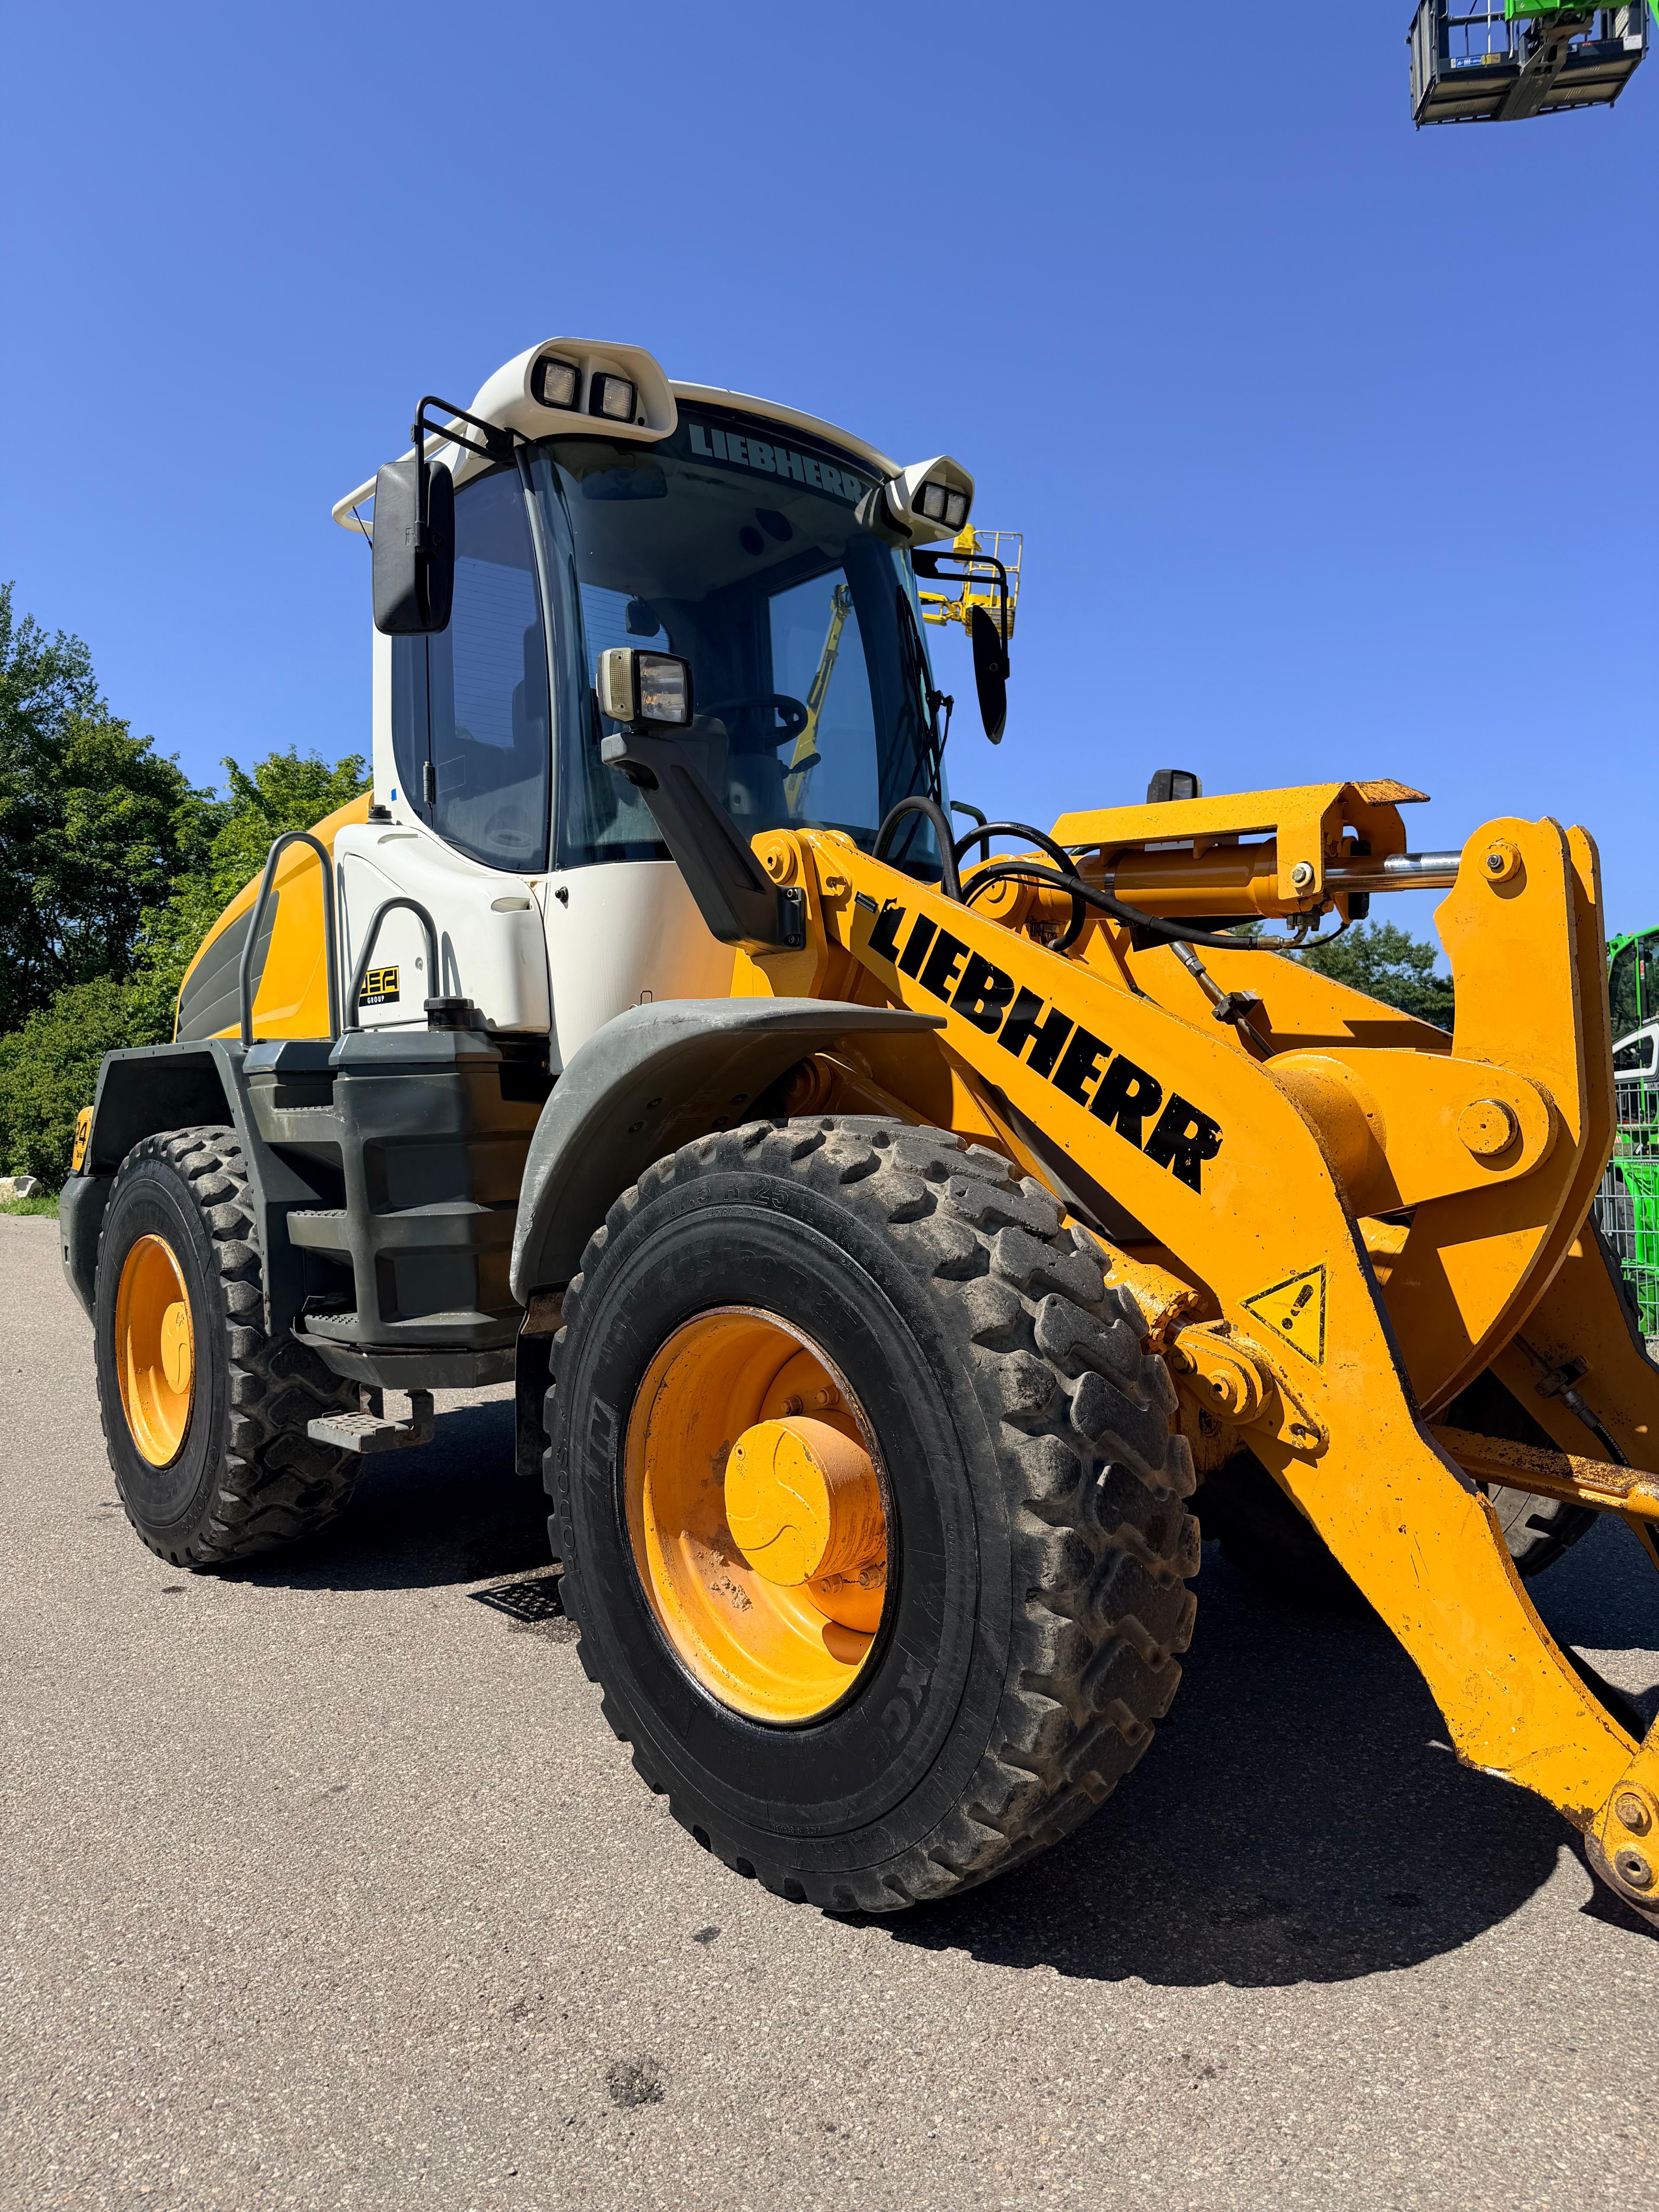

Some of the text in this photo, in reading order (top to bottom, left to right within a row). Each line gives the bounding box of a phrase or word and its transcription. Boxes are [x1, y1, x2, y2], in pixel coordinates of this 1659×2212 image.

[689, 424, 862, 503] LIEBHERR
[367, 995, 385, 1004] GROUP
[868, 897, 1223, 1195] LIEBHERR
[754, 1179, 791, 1210] 25
[557, 1446, 581, 1577] RODOS
[794, 1825, 895, 1869] CARRY
